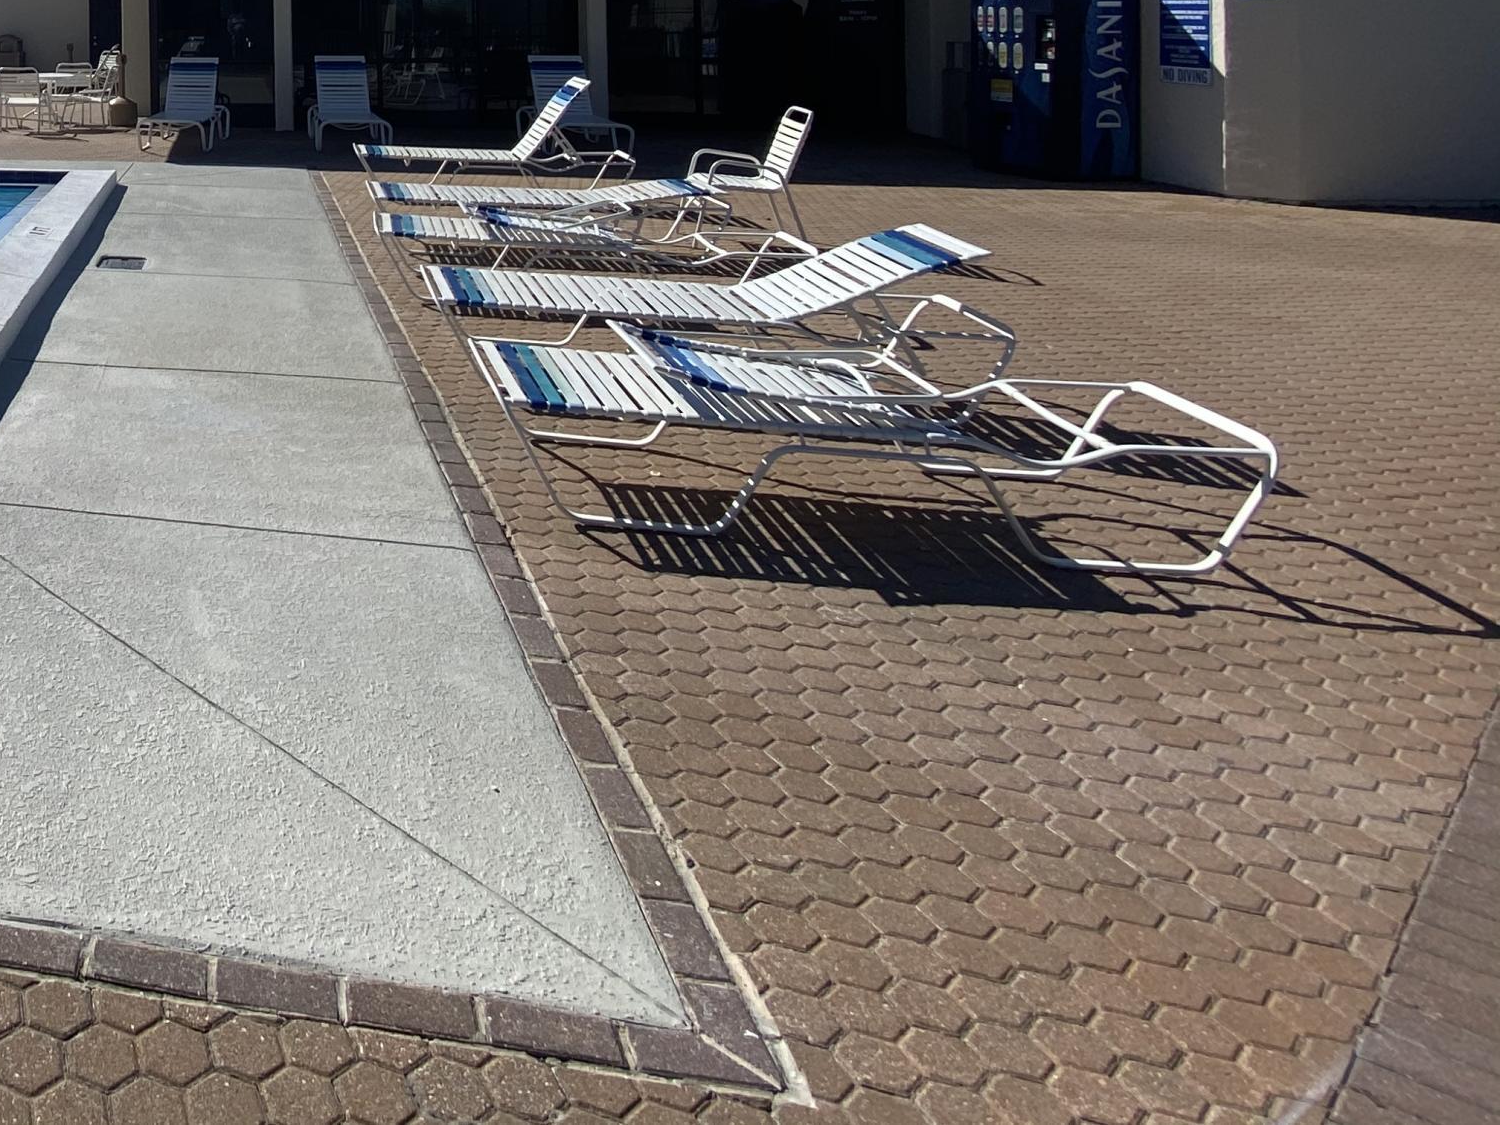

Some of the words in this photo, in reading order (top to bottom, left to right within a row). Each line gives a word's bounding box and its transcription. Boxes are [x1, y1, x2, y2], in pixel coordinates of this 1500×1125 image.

[1088, 0, 1129, 129] DASANI
[1162, 68, 1175, 81] NO
[1177, 68, 1208, 84] DIVING
